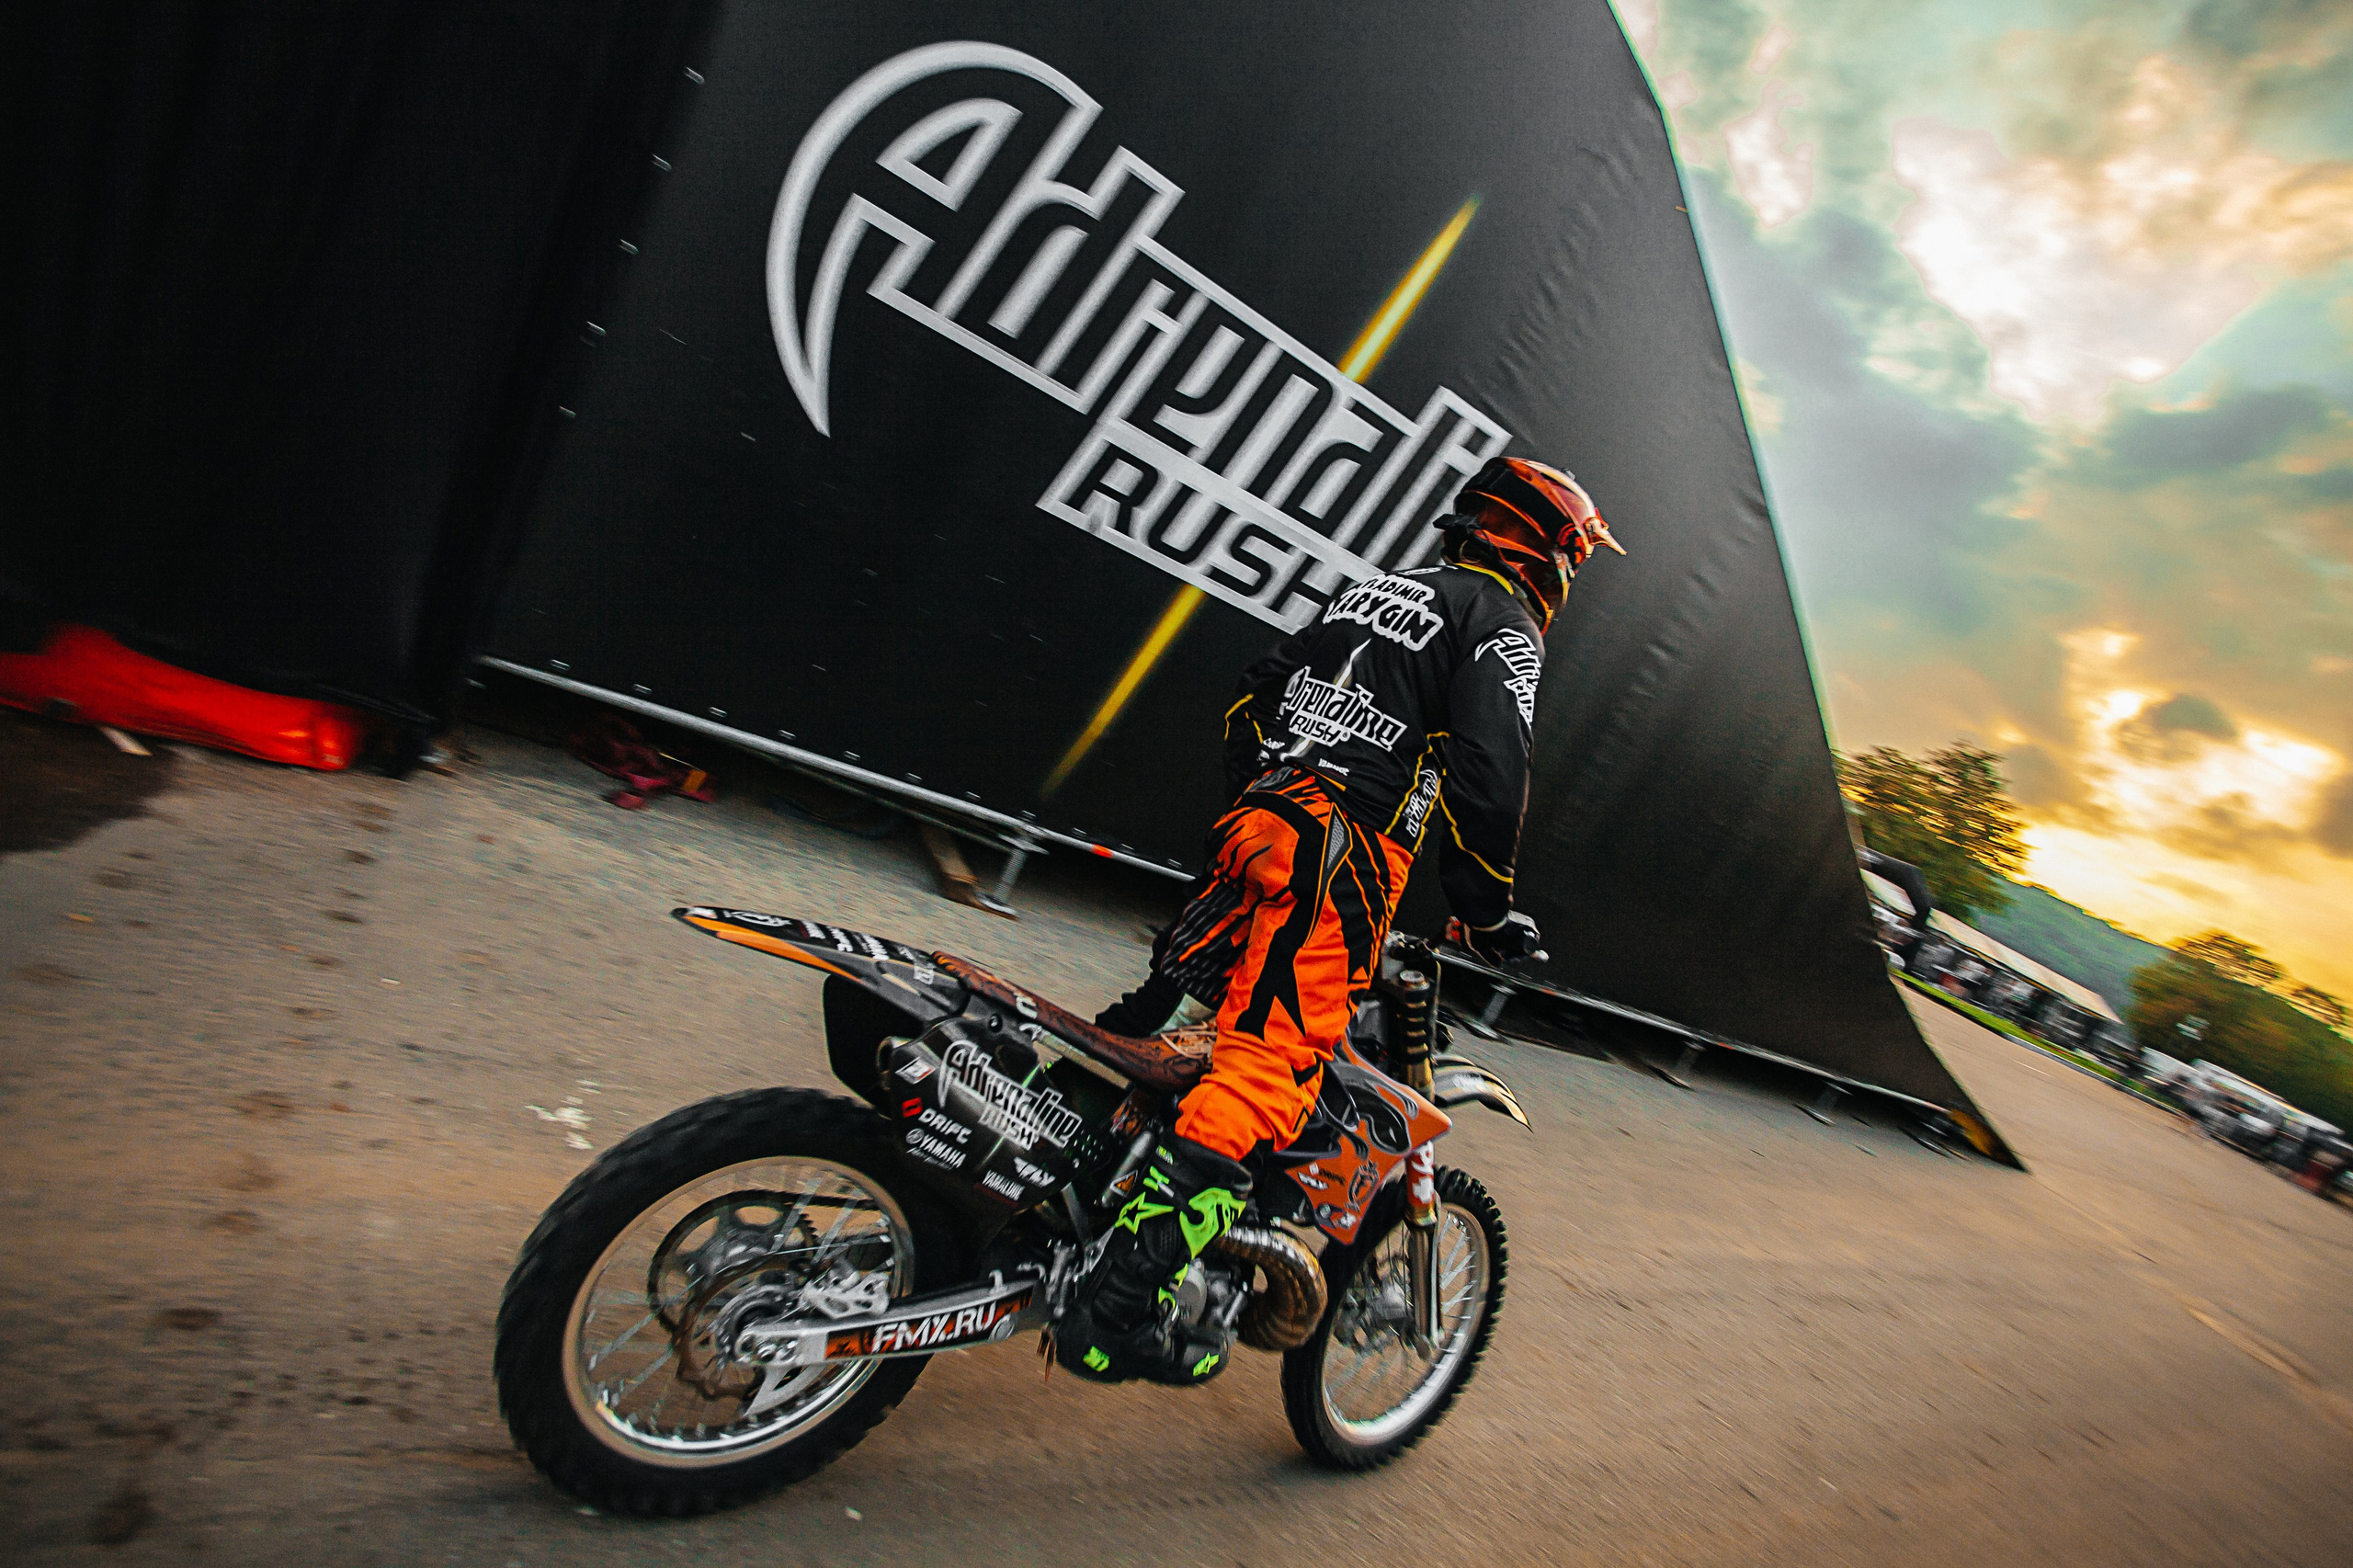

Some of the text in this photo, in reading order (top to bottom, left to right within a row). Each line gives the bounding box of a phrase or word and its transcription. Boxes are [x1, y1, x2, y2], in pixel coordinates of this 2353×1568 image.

[766, 40, 1513, 576] Adrenali
[1050, 436, 1362, 627] RUSH
[1289, 711, 1342, 745] RUSH
[919, 1133, 967, 1169] YAMAHA
[871, 1301, 997, 1355] FMX.RU
